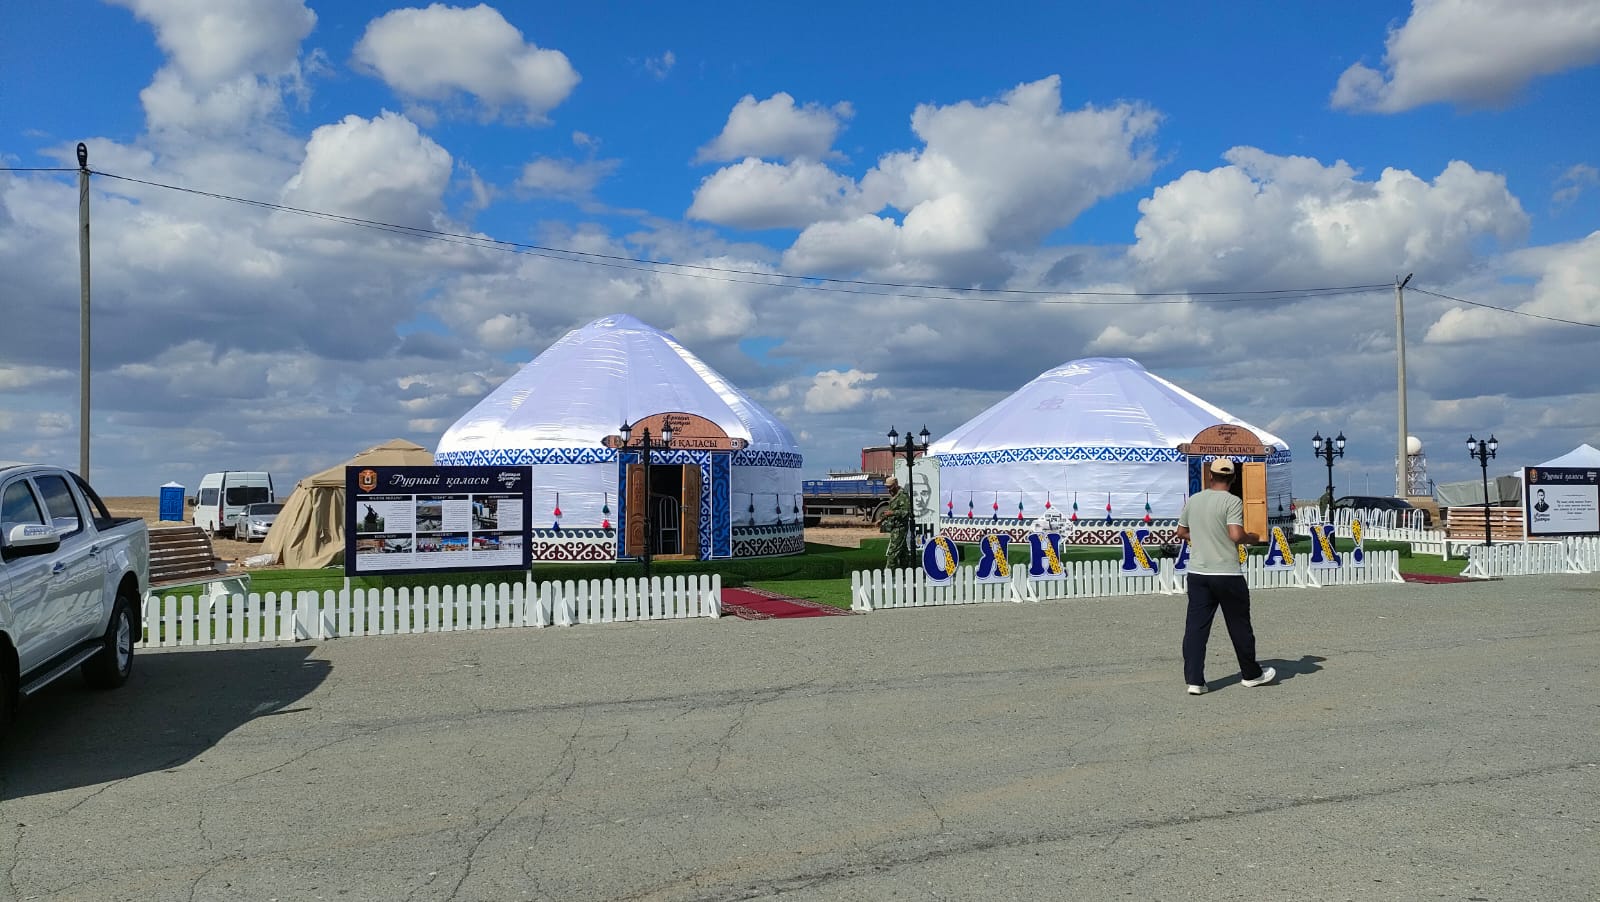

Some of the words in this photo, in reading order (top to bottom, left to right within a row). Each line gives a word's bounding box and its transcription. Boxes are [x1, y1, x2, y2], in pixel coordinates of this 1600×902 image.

[678, 439, 718, 448] ҚАЛАСЫ
[389, 474, 440, 487] Рудный
[446, 476, 489, 488] қаласы
